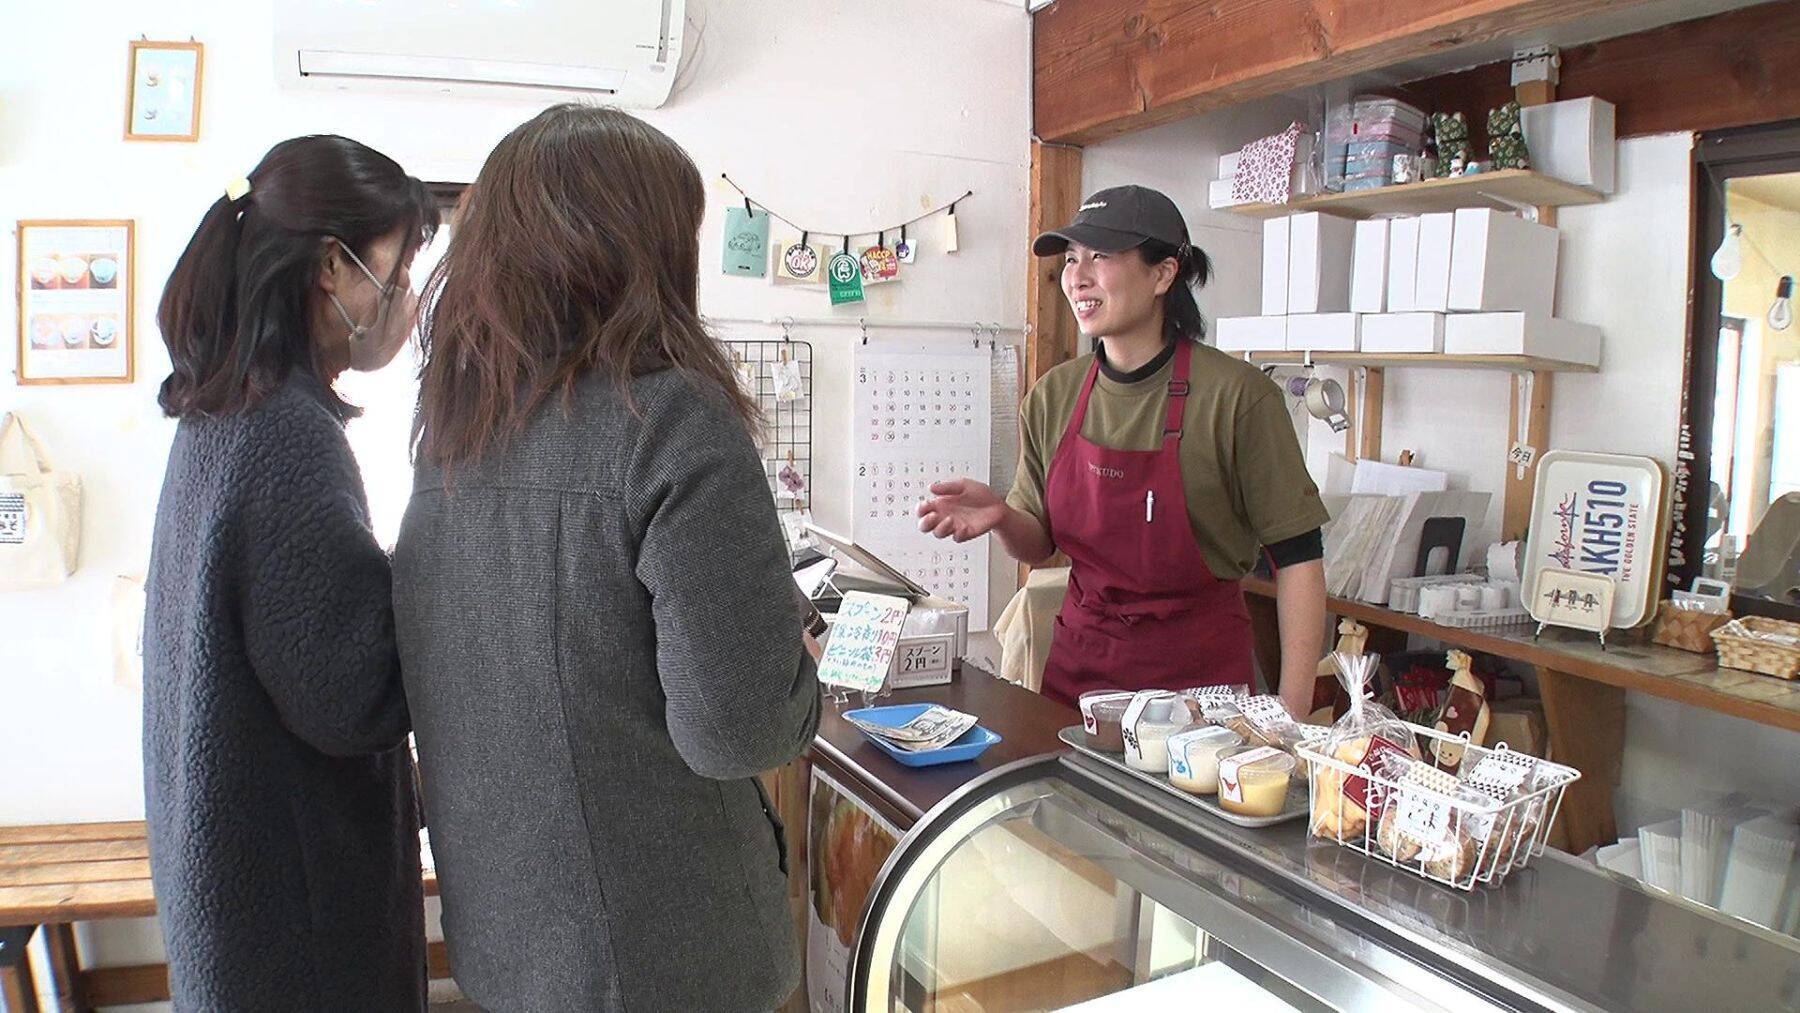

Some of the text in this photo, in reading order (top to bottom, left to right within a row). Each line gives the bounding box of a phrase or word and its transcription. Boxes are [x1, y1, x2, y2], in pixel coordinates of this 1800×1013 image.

[791, 255, 811, 271] OK
[859, 374, 867, 383] 3
[859, 466, 866, 476] 2
[1628, 503, 1638, 529] STATE
[1623, 532, 1635, 564] GOLDEN
[906, 646, 941, 657] スプーン
[904, 657, 926, 671] 2円
